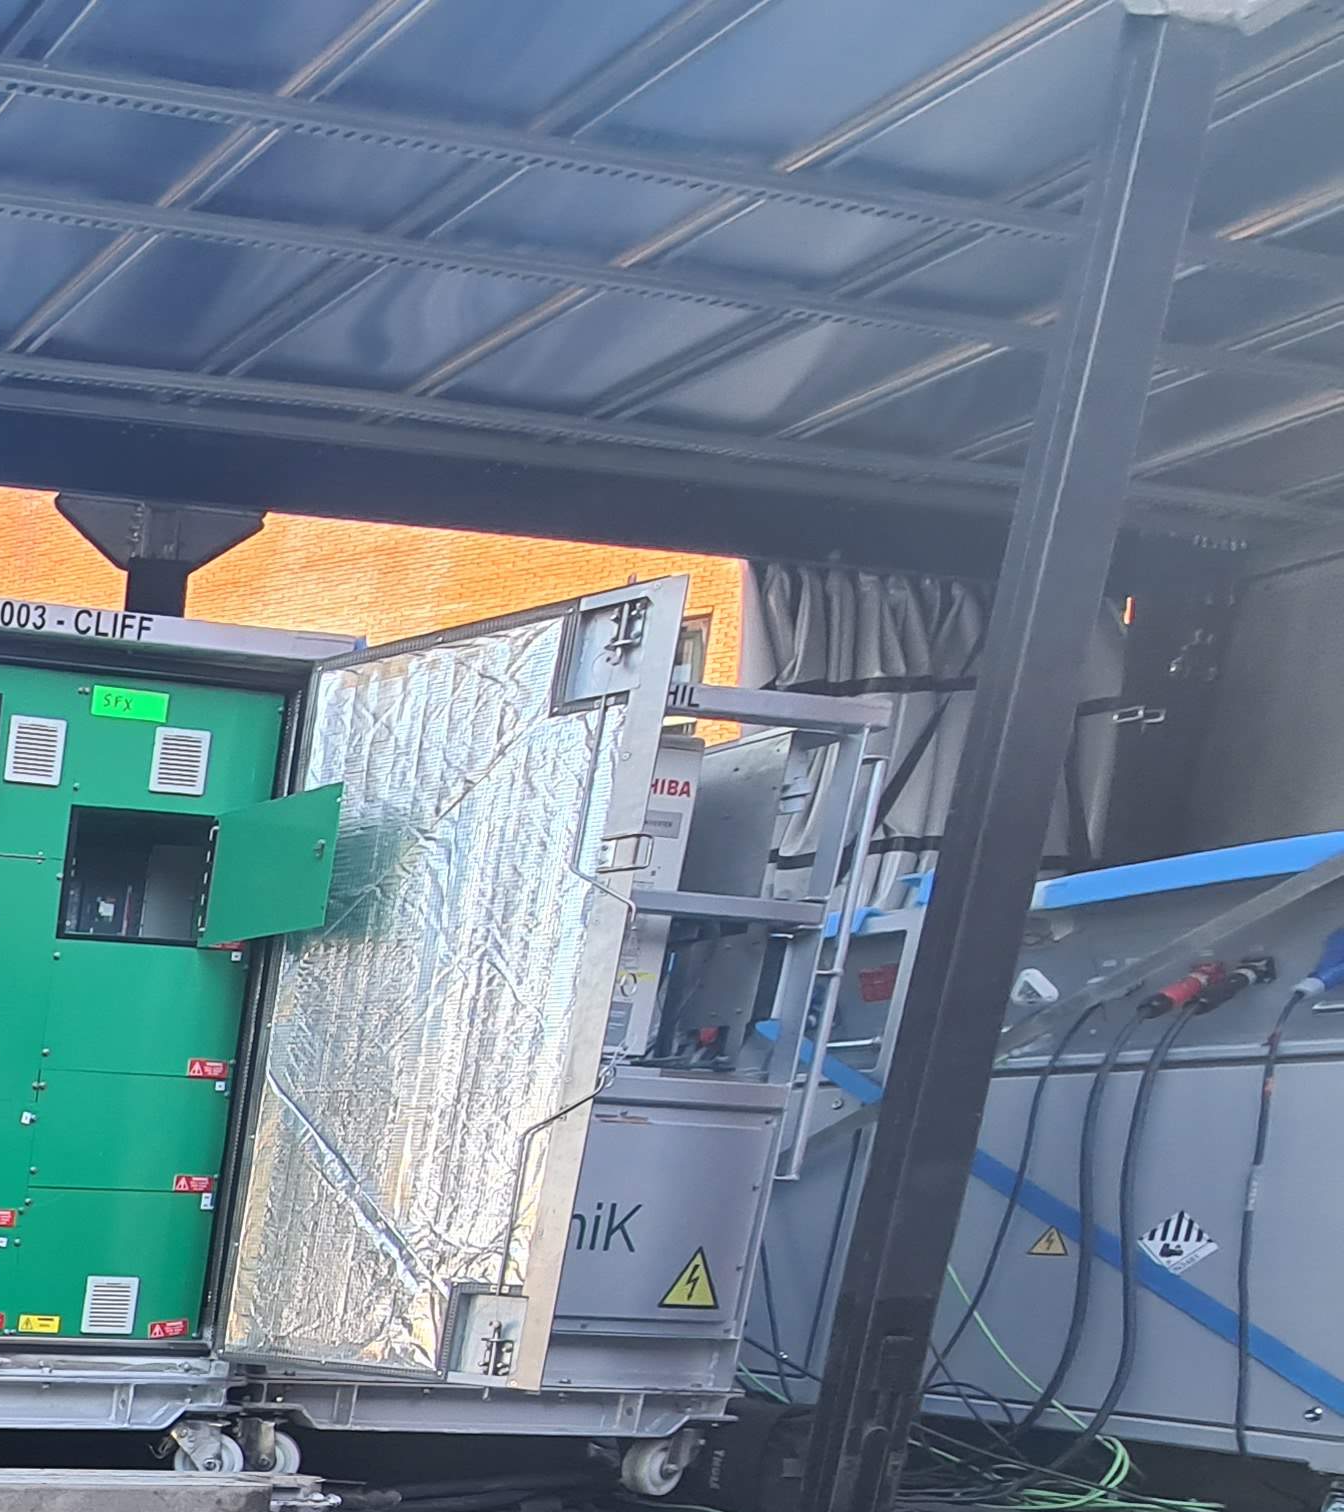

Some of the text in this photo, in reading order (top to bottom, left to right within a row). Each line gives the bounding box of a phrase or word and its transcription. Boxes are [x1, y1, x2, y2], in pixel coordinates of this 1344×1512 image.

[74, 609, 154, 641] CLIFF
[103, 693, 133, 712] SFX
[667, 684, 700, 708] HIL
[651, 778, 691, 798] HIBA
